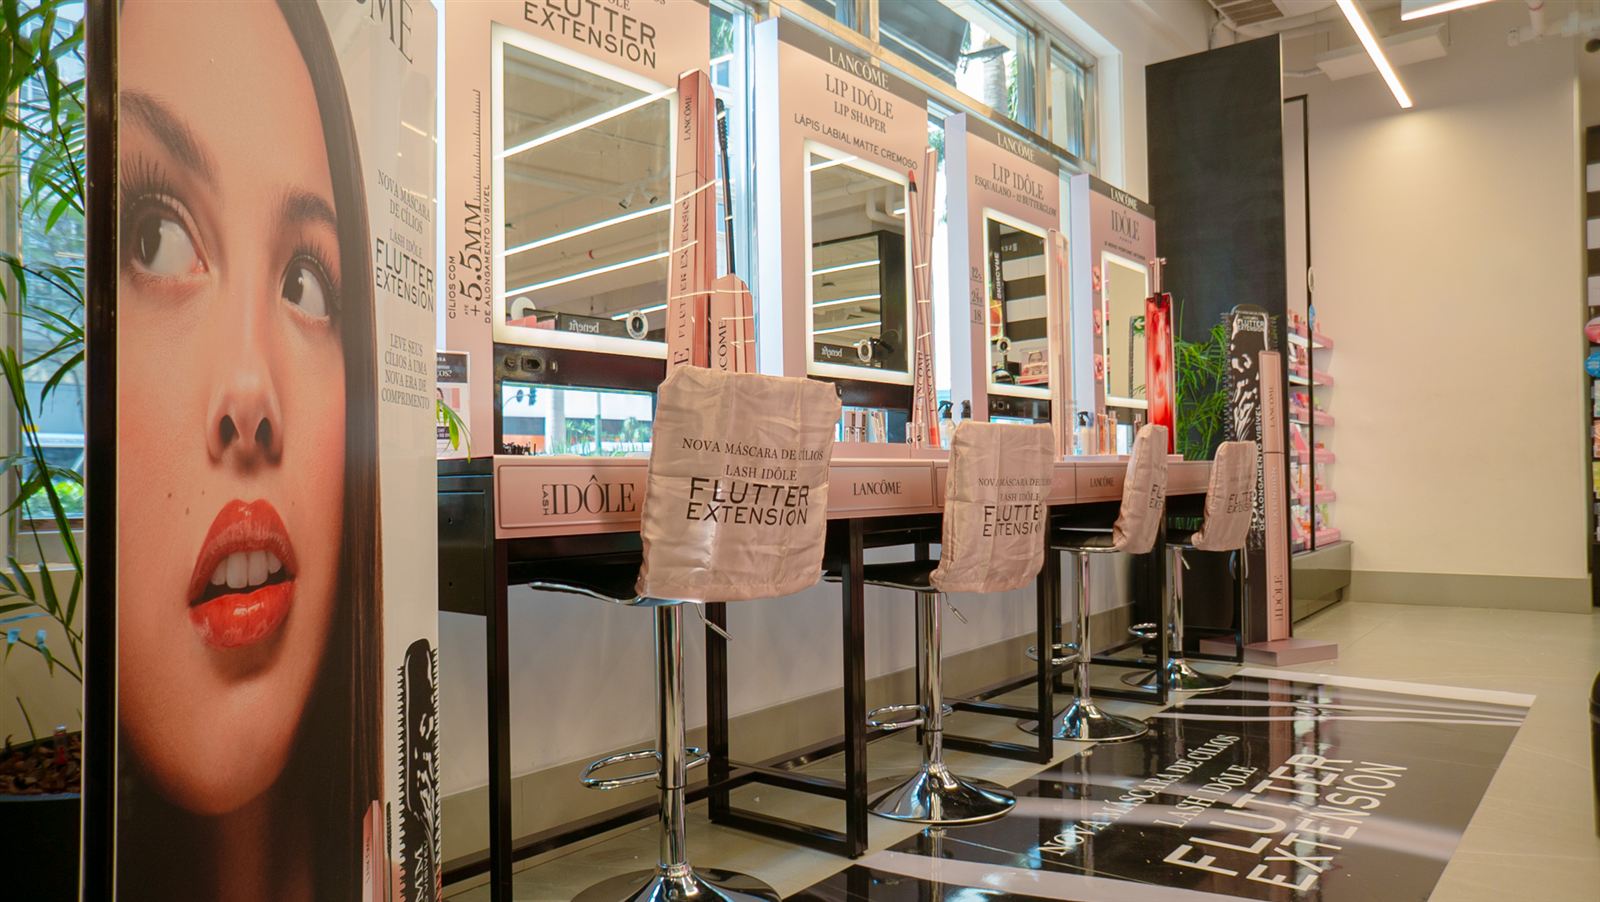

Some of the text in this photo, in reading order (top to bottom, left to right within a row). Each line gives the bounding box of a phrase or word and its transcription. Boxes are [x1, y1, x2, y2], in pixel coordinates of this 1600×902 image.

[524, 1, 656, 69] EXTENSION
[829, 47, 889, 90] LANCÔME
[825, 73, 894, 120] LIP IDÔLE
[834, 101, 887, 134] LIP SHAPER
[794, 113, 918, 170] LÁPIS LABIAL MATTE CREMOSO
[992, 163, 1045, 201] LIP IDÔLE
[376, 237, 434, 293] FLUTTER
[483, 226, 491, 311] ALONGAMENTO
[376, 266, 435, 313] EXTENSION
[448, 256, 456, 320] CÍLIOS COM
[484, 311, 491, 324] DE
[381, 387, 431, 410] COMPRIMENTO
[681, 438, 721, 453] NOVA
[725, 442, 778, 459] MÁSCARA
[781, 448, 797, 461] DE
[551, 474, 636, 515] IDÔLE
[690, 477, 810, 508] FLUTTER
[725, 465, 797, 481] LASH IDÔLE
[853, 479, 902, 496] LANCÔME
[1257, 443, 1265, 516] ALONGAMENTO
[686, 502, 808, 527] EXTENSION
[984, 504, 1042, 522] FLUTTE
[1037, 734, 1241, 857] NOVA MÁSCARA DE CÍLIOS
[1153, 764, 1259, 829] LASH IDÔLE
[1162, 753, 1353, 877] FLUTTER
[1246, 761, 1408, 892] EXTENSION
